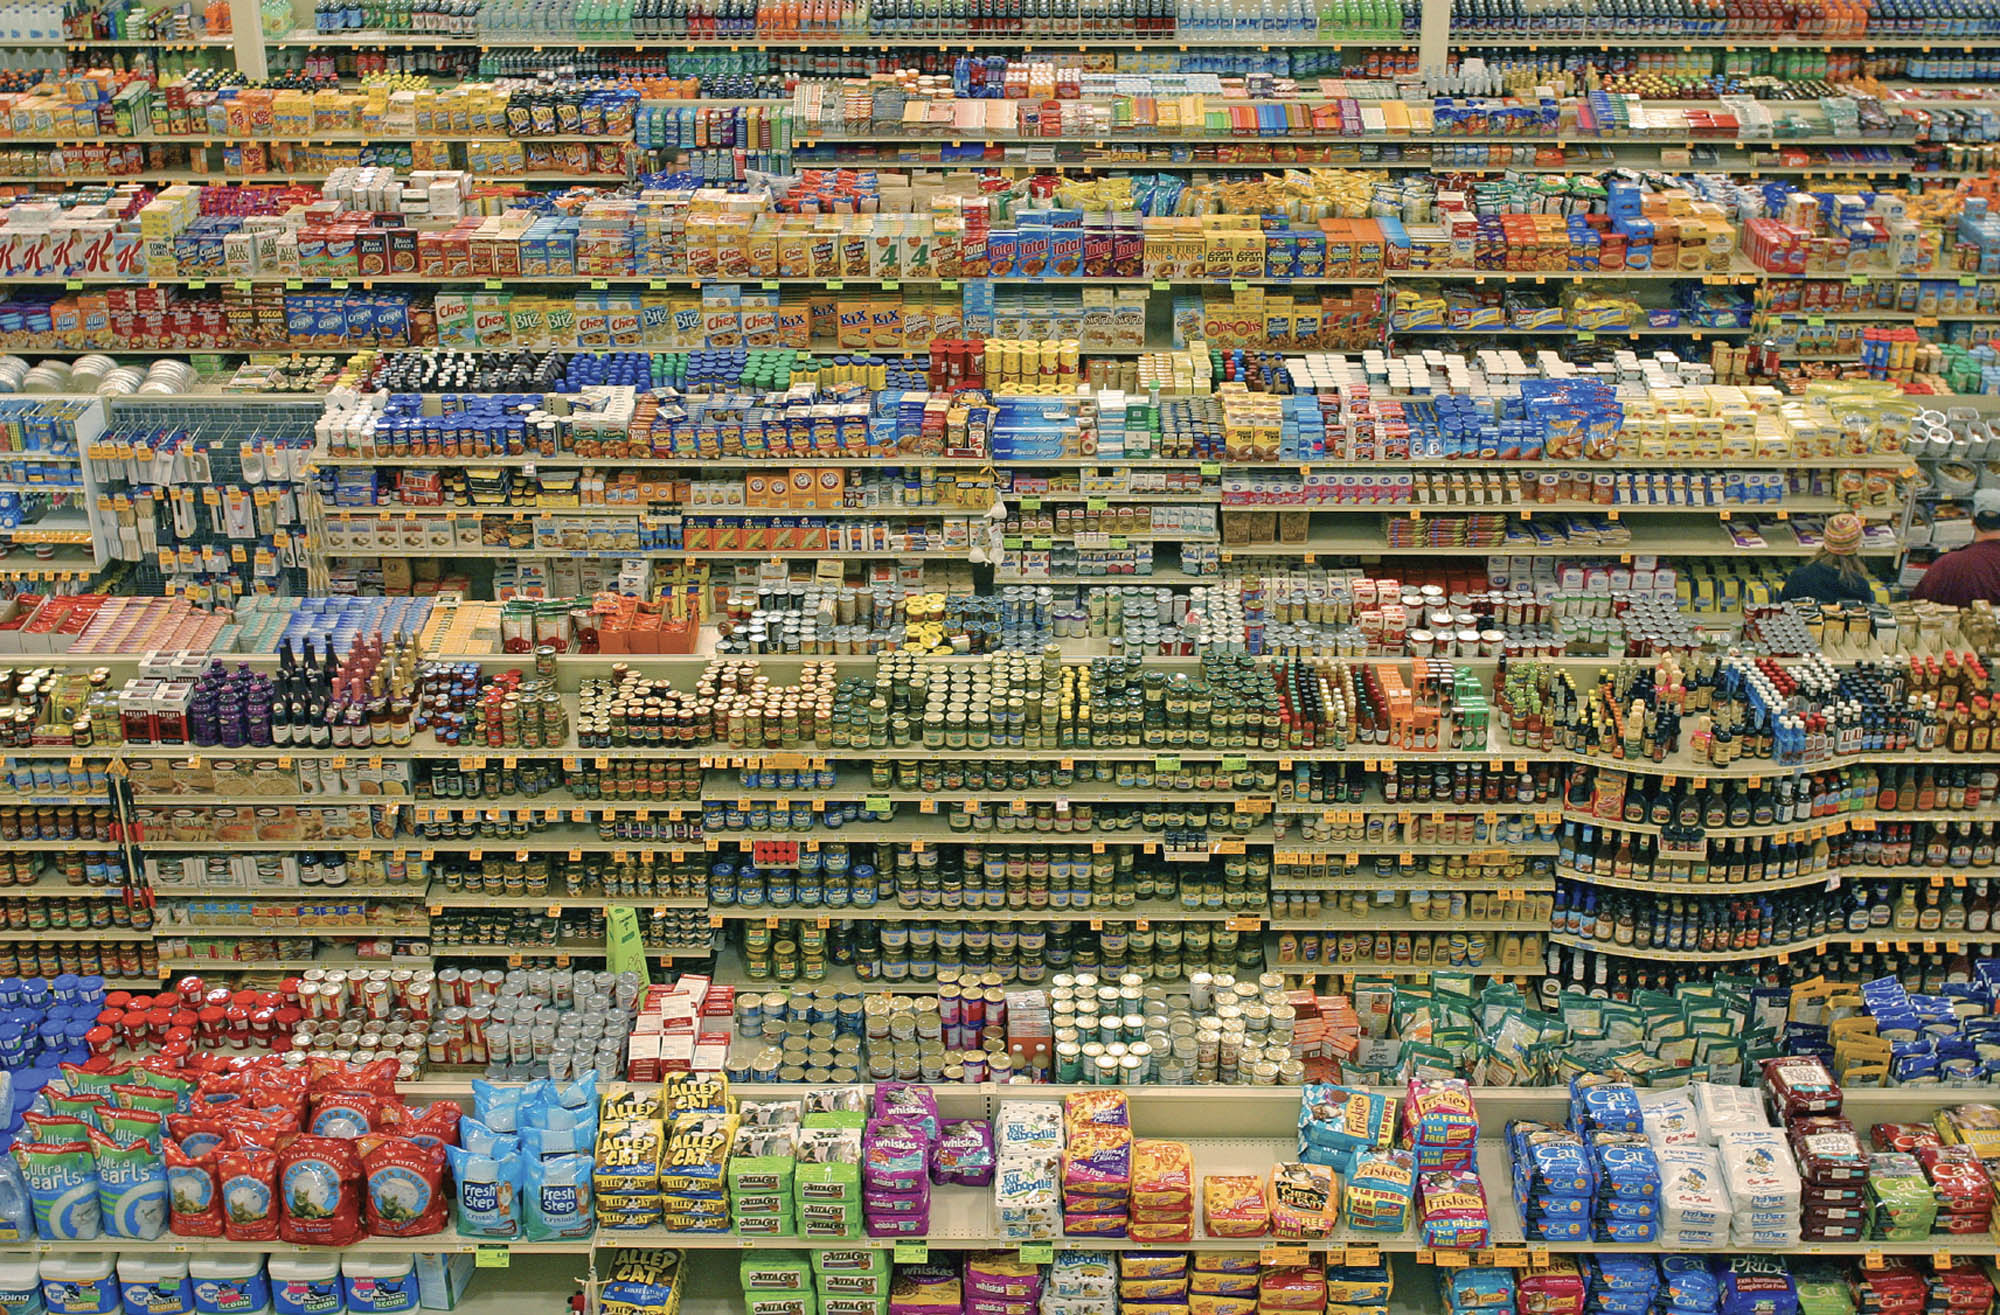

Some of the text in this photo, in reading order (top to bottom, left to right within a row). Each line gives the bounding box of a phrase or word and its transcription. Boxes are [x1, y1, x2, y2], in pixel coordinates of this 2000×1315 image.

[1021, 240, 1049, 253] Total
[1052, 240, 1081, 253] Total
[439, 304, 468, 318] Chex
[477, 314, 506, 329] Chex
[580, 317, 606, 330] Chex
[612, 317, 638, 330] Chex
[707, 315, 737, 330] Chex
[745, 315, 774, 330] Chex
[670, 1081, 720, 1099] ALLEY
[676, 1095, 709, 1110] CAT
[1421, 1093, 1467, 1109] Friskies
[1587, 1090, 1627, 1105] Cat
[887, 1105, 928, 1115] whiskas
[1351, 1096, 1366, 1135] Friskies
[1383, 1100, 1395, 1125] FREE
[1007, 1124, 1025, 1134] Kit
[1007, 1128, 1057, 1140] Kaboodle
[603, 1135, 655, 1153] ALLEY
[672, 1133, 724, 1149] ALLEY
[875, 1139, 917, 1149] whiskas
[942, 1137, 983, 1148] whiskas
[605, 1149, 644, 1166] CAT
[672, 1147, 712, 1166] CAT
[1535, 1146, 1577, 1162] Cat
[1599, 1147, 1645, 1164] Cat
[30, 1163, 62, 1175] Ultra
[23, 1168, 82, 1190] Pearls
[1003, 1171, 1021, 1185] Kit
[464, 1181, 497, 1198] Fresh
[543, 1186, 576, 1201] Fresh
[1001, 1180, 1053, 1198] Kaboodle
[465, 1195, 495, 1210] Step
[1373, 1191, 1405, 1202] FREE
[1427, 1195, 1480, 1208] Friskies
[544, 1199, 574, 1212] Step
[1548, 1202, 1568, 1212] Cat
[1618, 1205, 1636, 1215] Cat
[1452, 1219, 1484, 1228] FREE
[1548, 1225, 1567, 1235] Cat
[1951, 1219, 1972, 1230] Cat
[1616, 1226, 1635, 1237] Cat
[615, 1249, 678, 1269] ALLEY
[902, 1266, 954, 1277] whiskas
[1729, 1258, 1788, 1275] PRIDE
[616, 1265, 664, 1285] CAT
[976, 1283, 1004, 1293] whiskas
[1608, 1279, 1632, 1288] Cat
[1798, 1286, 1839, 1298] Cat
[1949, 1293, 1973, 1304] Cat
[306, 1301, 337, 1310] SCOOP
[375, 1299, 407, 1308] SCOOP
[1602, 1301, 1626, 1310] Cat
[1674, 1296, 1698, 1306] Cat
[1880, 1297, 1904, 1308] Cat
[976, 1304, 1004, 1313] whiskas
